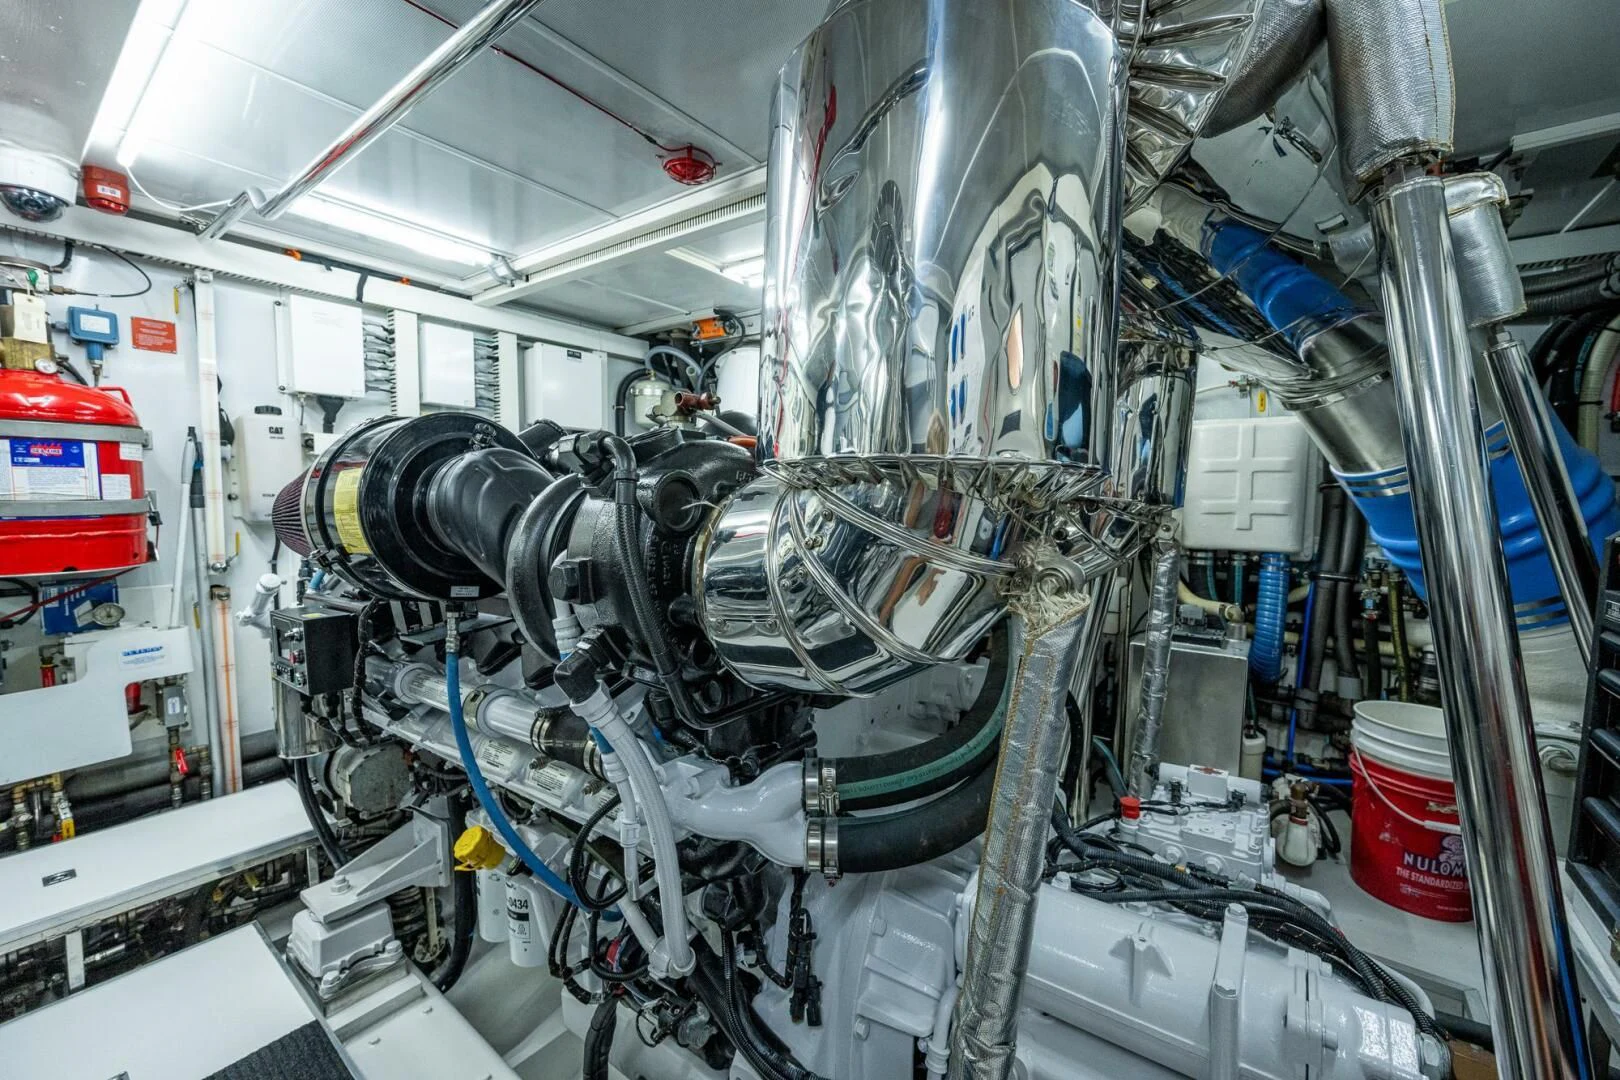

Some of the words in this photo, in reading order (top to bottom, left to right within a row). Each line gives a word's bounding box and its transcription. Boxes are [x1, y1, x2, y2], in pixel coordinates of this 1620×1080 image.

[269, 426, 284, 434] CAT
[1403, 851, 1468, 878] NULOM
[1396, 866, 1411, 880] THE
[1411, 871, 1464, 890] STANDARDIZED
